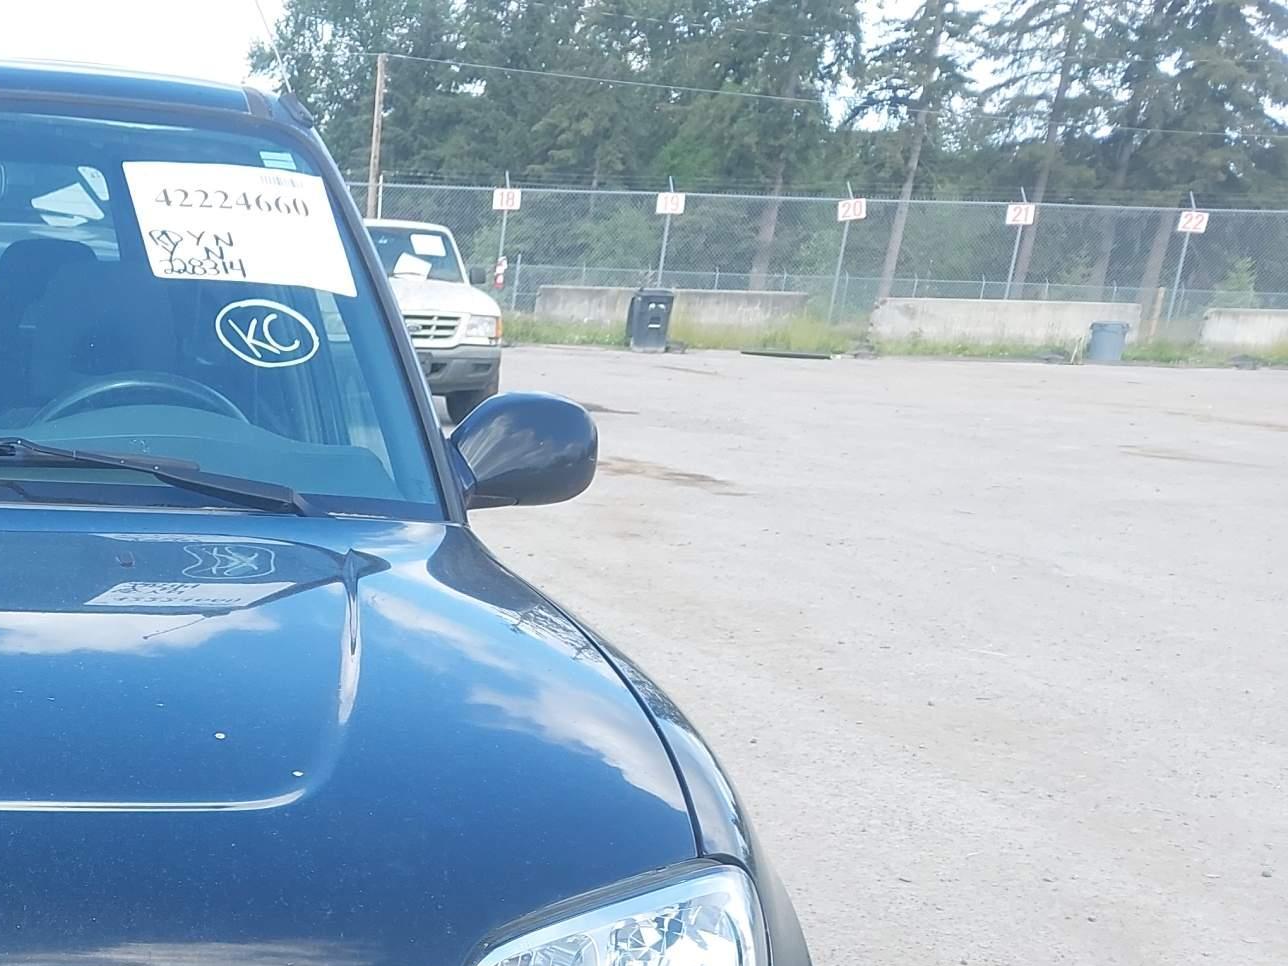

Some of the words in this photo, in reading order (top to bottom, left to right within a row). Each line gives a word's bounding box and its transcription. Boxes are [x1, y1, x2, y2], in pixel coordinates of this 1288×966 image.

[155, 188, 309, 216] 42224660
[498, 191, 515, 207] 18
[663, 195, 680, 212] 19
[841, 202, 861, 219] 20
[1012, 206, 1030, 223] 21
[1182, 213, 1205, 230] 22
[228, 313, 301, 358] KC
